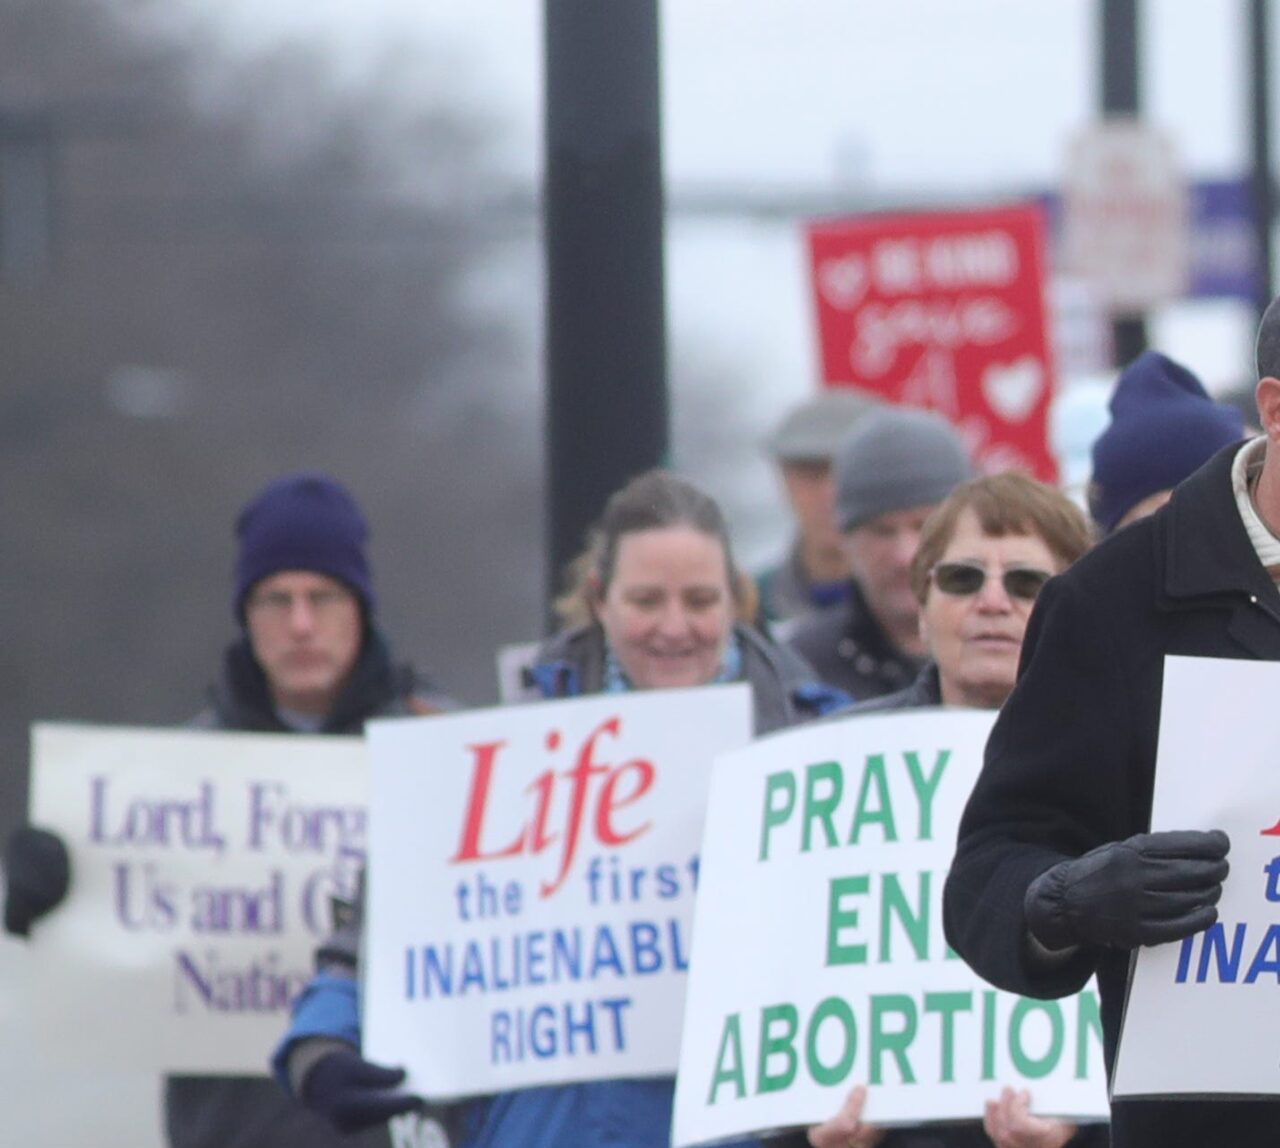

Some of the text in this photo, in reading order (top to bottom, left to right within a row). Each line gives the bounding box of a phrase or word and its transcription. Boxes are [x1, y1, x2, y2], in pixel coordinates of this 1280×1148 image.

[90, 775, 226, 857] Lord,
[447, 715, 657, 898] Life
[758, 750, 952, 861] PRAY
[115, 862, 178, 933] Us
[191, 868, 286, 936] and
[456, 872, 524, 921] the
[825, 871, 961, 966] EN
[490, 997, 632, 1065] RIGHT
[707, 989, 1104, 1105] ABORTION
